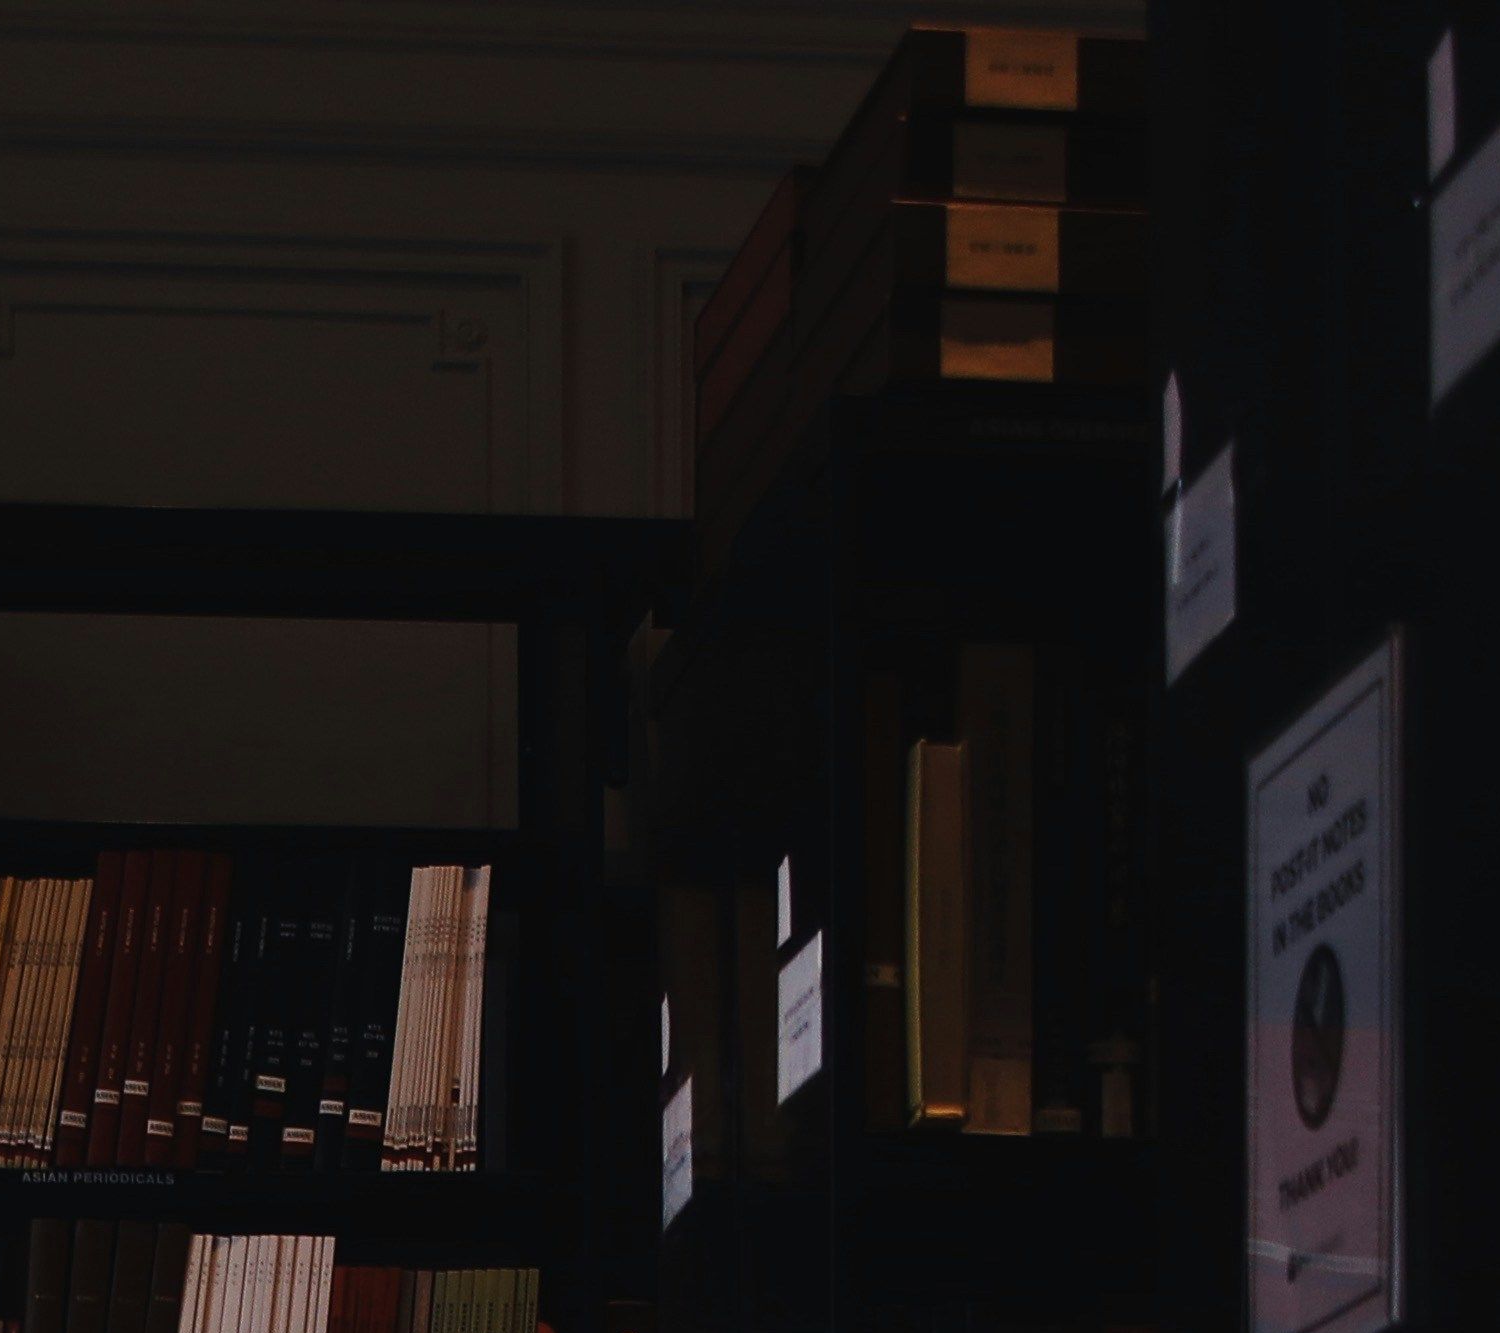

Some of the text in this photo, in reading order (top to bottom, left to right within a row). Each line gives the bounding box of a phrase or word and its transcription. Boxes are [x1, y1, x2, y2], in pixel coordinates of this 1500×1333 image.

[1307, 773, 1329, 815] NO
[1321, 798, 1367, 859] NOTES
[1272, 920, 1286, 956] IN
[1317, 858, 1364, 923] BOOKS
[22, 1171, 174, 1185] ASIAN PERIODICALS
[1278, 1158, 1325, 1212] THANK
